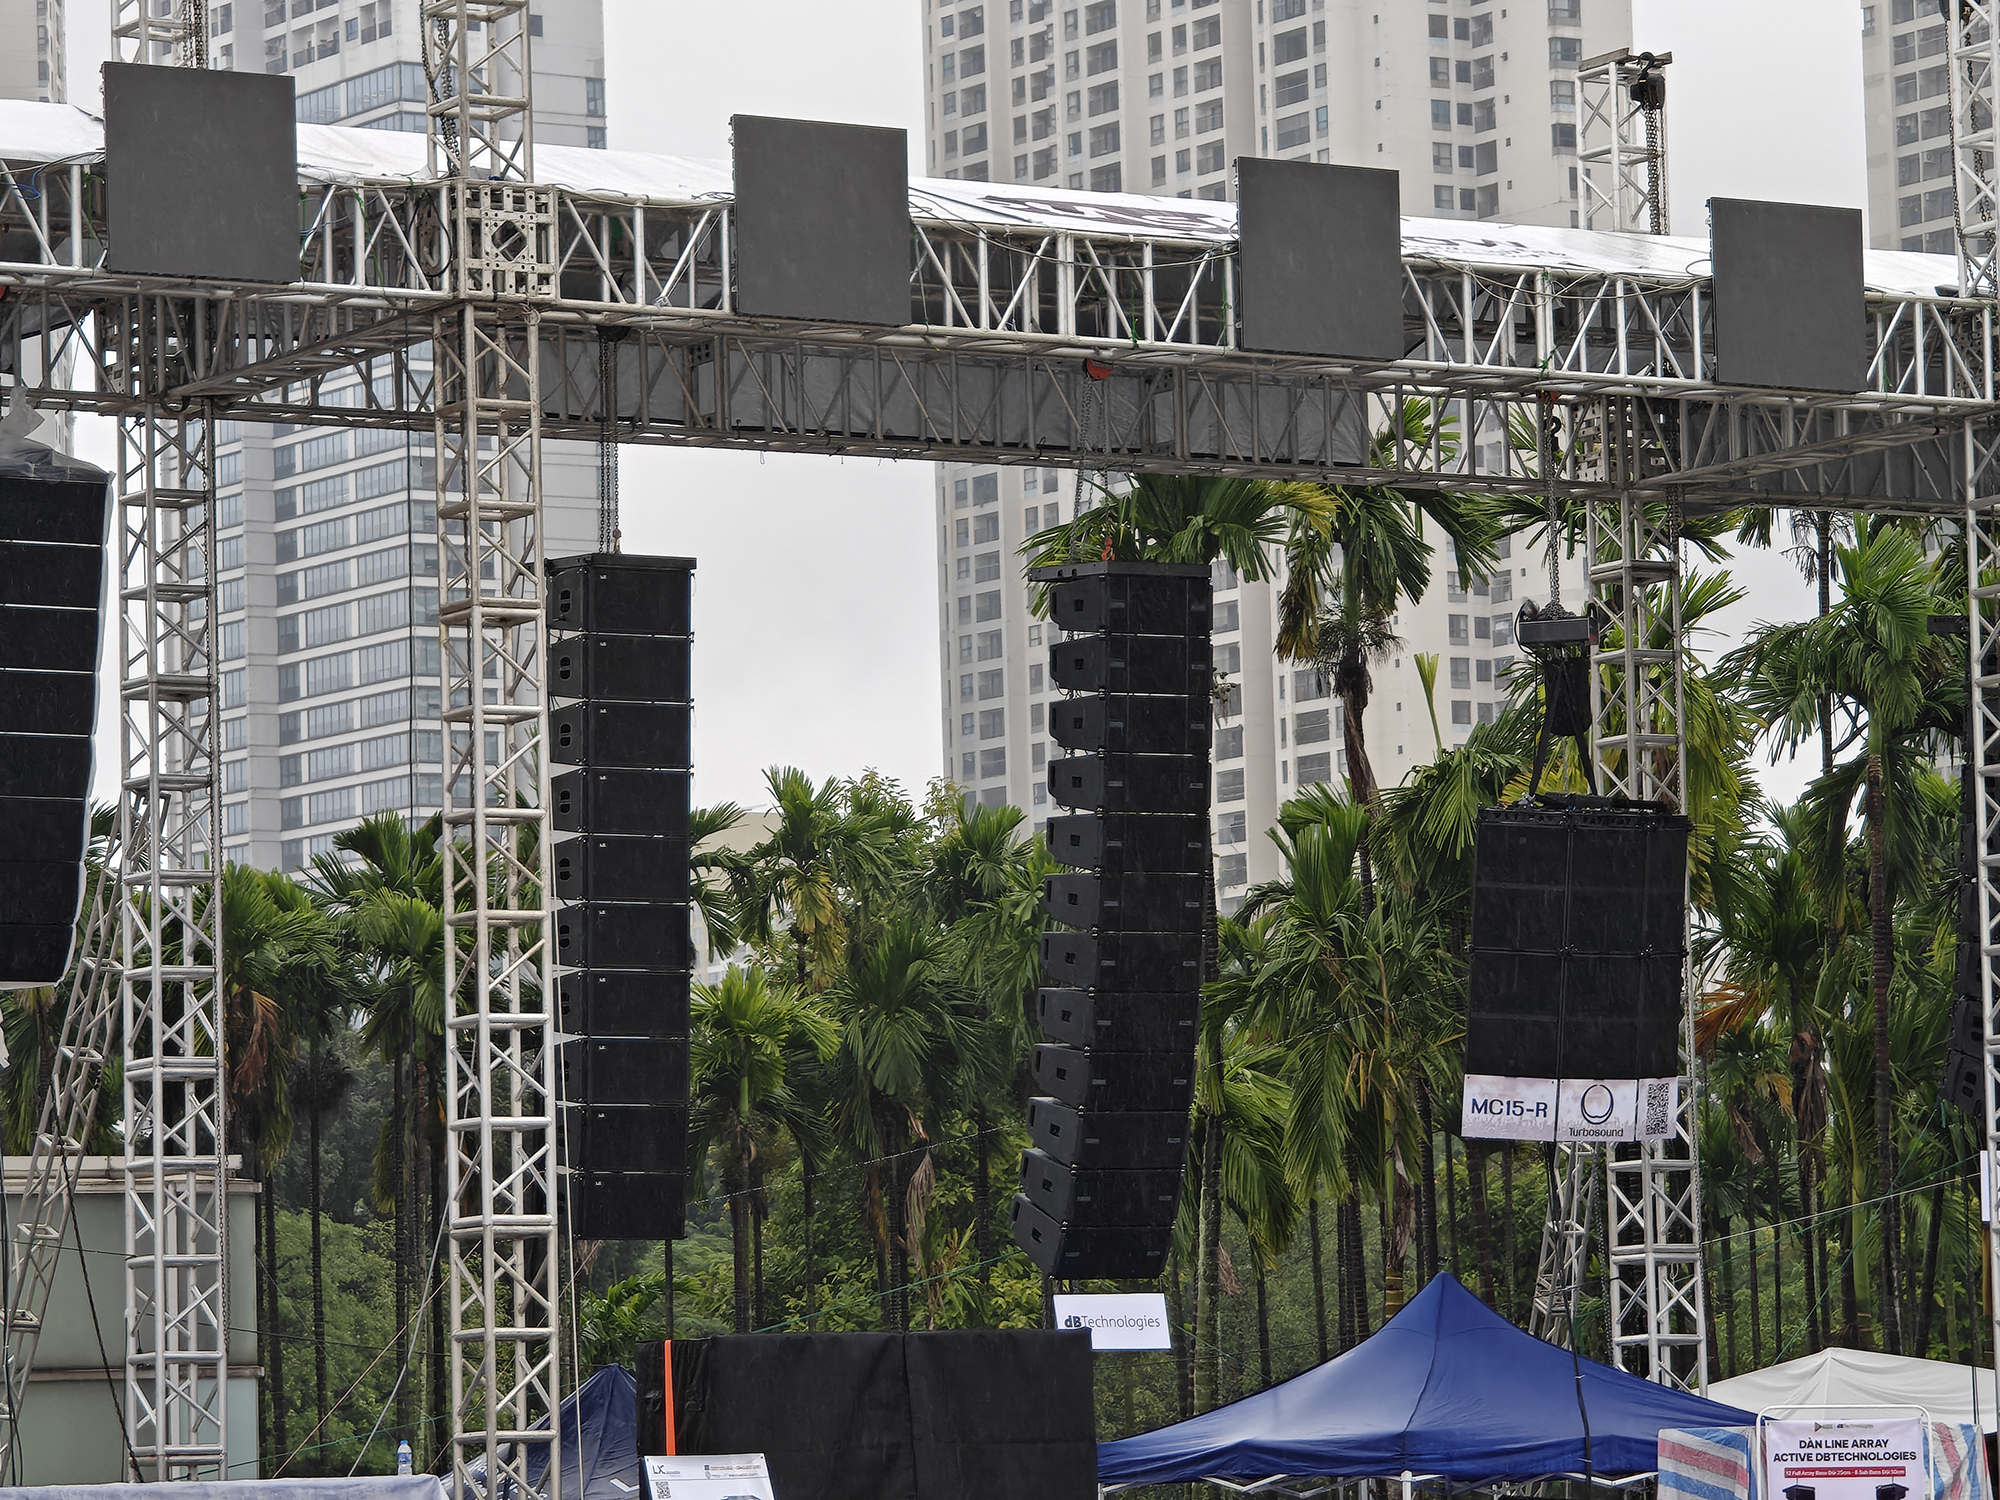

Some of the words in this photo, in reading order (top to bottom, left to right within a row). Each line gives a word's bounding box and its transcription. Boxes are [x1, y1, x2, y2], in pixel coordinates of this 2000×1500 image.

[1471, 1098, 1548, 1118] MC15-R
[1569, 1127, 1624, 1137] Turbosound
[1064, 1315, 1161, 1331] dBTechnologies
[1799, 1437, 1823, 1449] DÀN
[1825, 1439, 1849, 1449] LINE
[1851, 1438, 1889, 1448] ARRAY
[1773, 1452, 1813, 1462] ACTIVE
[1815, 1451, 1917, 1462] DBTECHNOLOGIES
[652, 1464, 666, 1475] LX
